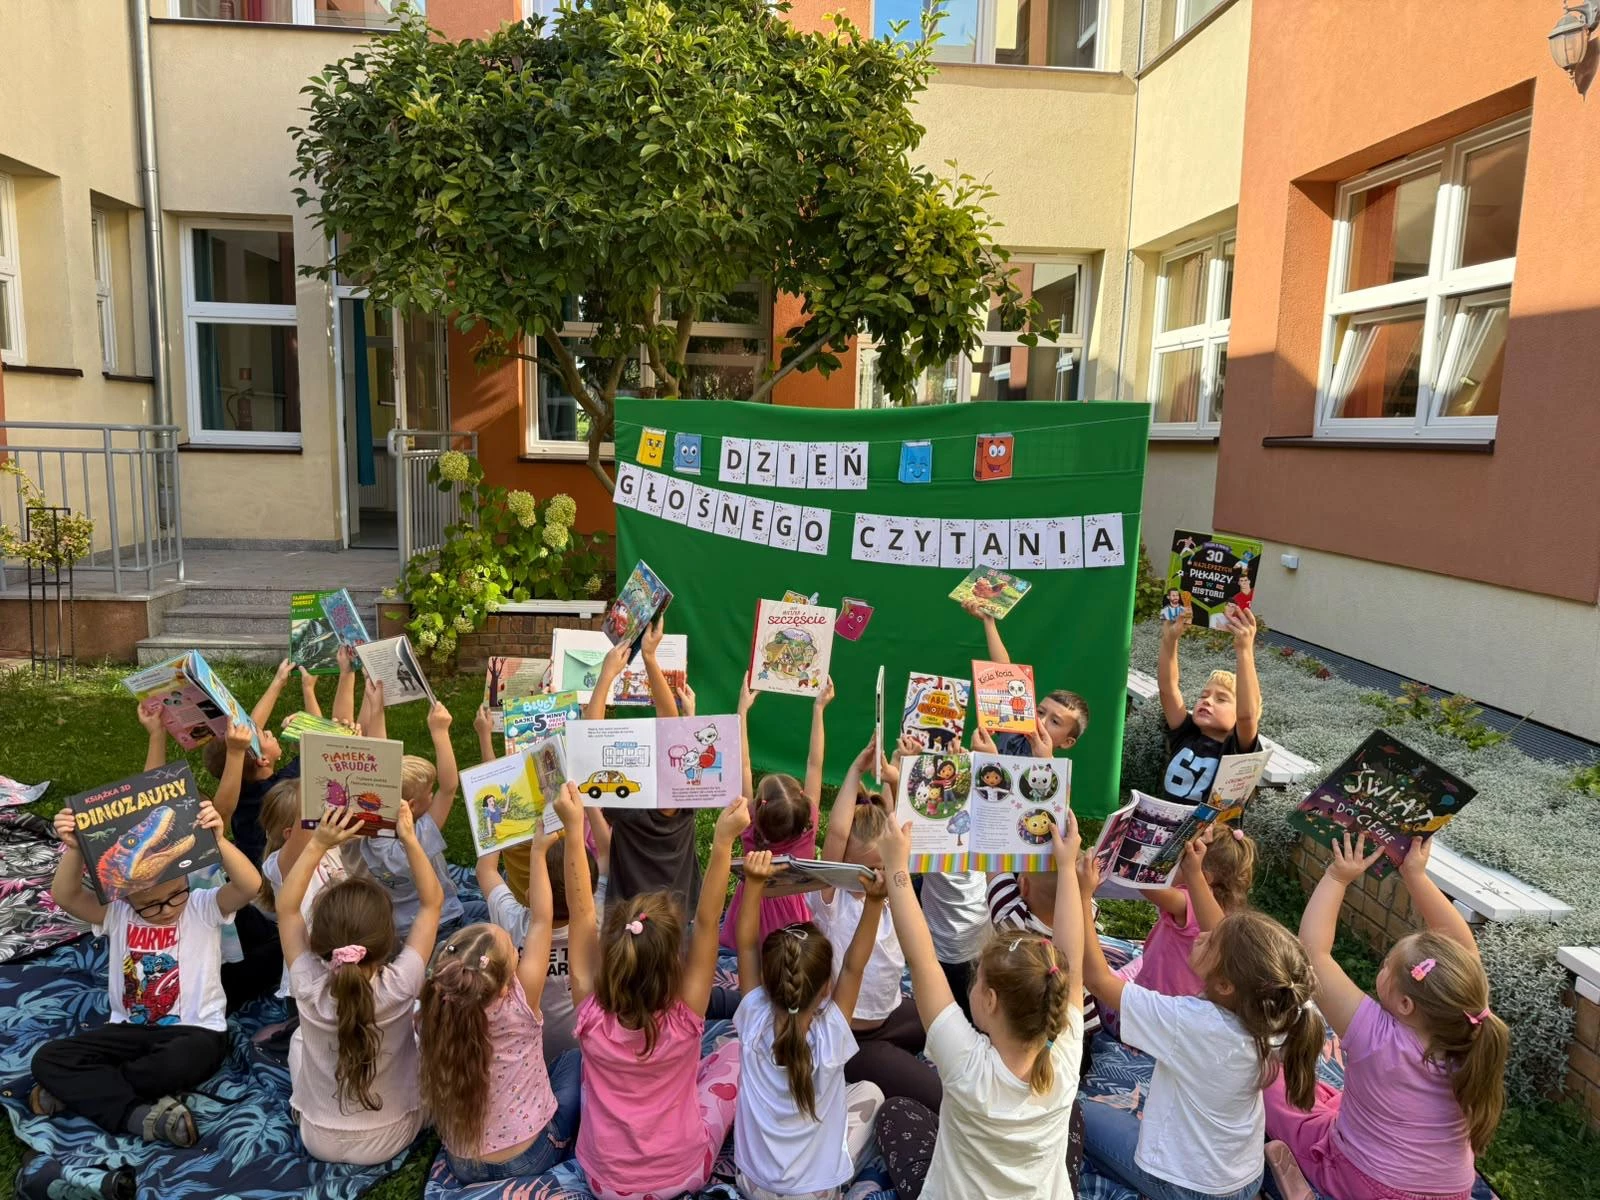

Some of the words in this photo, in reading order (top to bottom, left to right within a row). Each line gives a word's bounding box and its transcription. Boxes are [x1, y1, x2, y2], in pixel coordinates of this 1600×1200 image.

[726, 448, 862, 477] DZIEŃ
[620, 475, 823, 542] GŁOŚNEGO
[860, 526, 1114, 556] CZYTANIA
[1206, 550, 1224, 563] 30
[1189, 568, 1234, 584] PIŁKARZY
[1191, 586, 1225, 599] HISTORII
[767, 612, 827, 627] szczęście
[532, 713, 548, 732] 5
[322, 752, 365, 762] PLAMEK
[334, 761, 378, 772] BRUDEK
[84, 788, 120, 804] KSIĄŻKA
[119, 783, 132, 793] 3D
[1344, 762, 1435, 823] ŚWIAT
[75, 778, 187, 831] DINOZAURY
[1336, 802, 1355, 817] DO
[1356, 814, 1397, 845] CIEBIE
[127, 923, 178, 951] MARVEL
